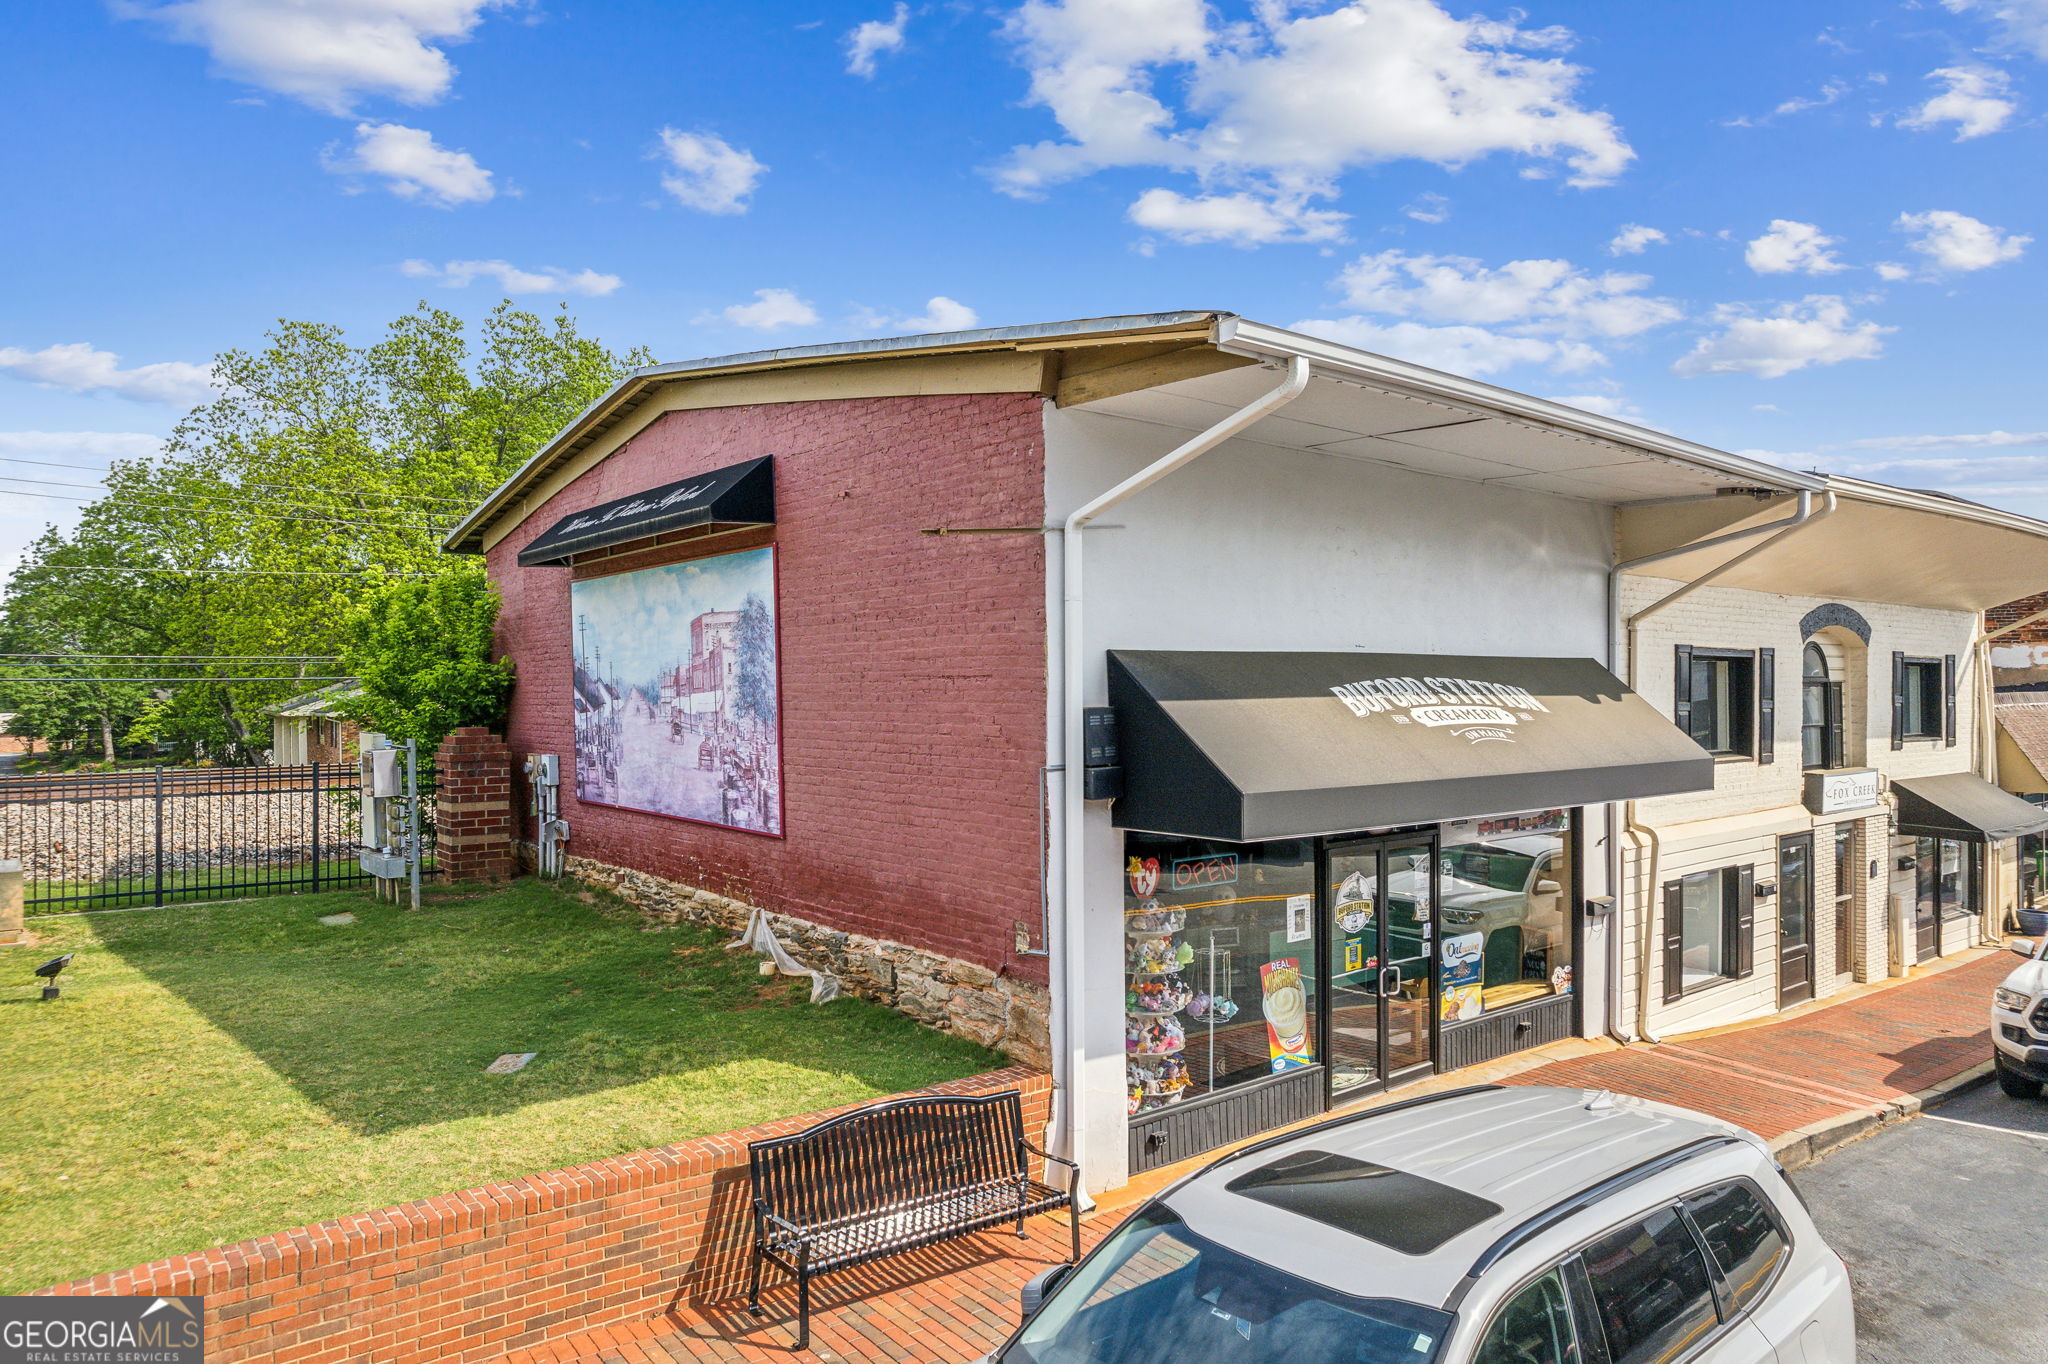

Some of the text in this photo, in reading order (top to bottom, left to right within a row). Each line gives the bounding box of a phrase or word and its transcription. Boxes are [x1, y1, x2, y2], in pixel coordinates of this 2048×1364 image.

[1329, 676, 1553, 718] BUFORD STATION
[1423, 708, 1503, 723] CREAMERY
[1465, 729, 1507, 739] ON MAIN
[1833, 785, 1876, 799] FOX CREEK
[1176, 856, 1236, 886] OPEN
[1271, 959, 1291, 972] REAL
